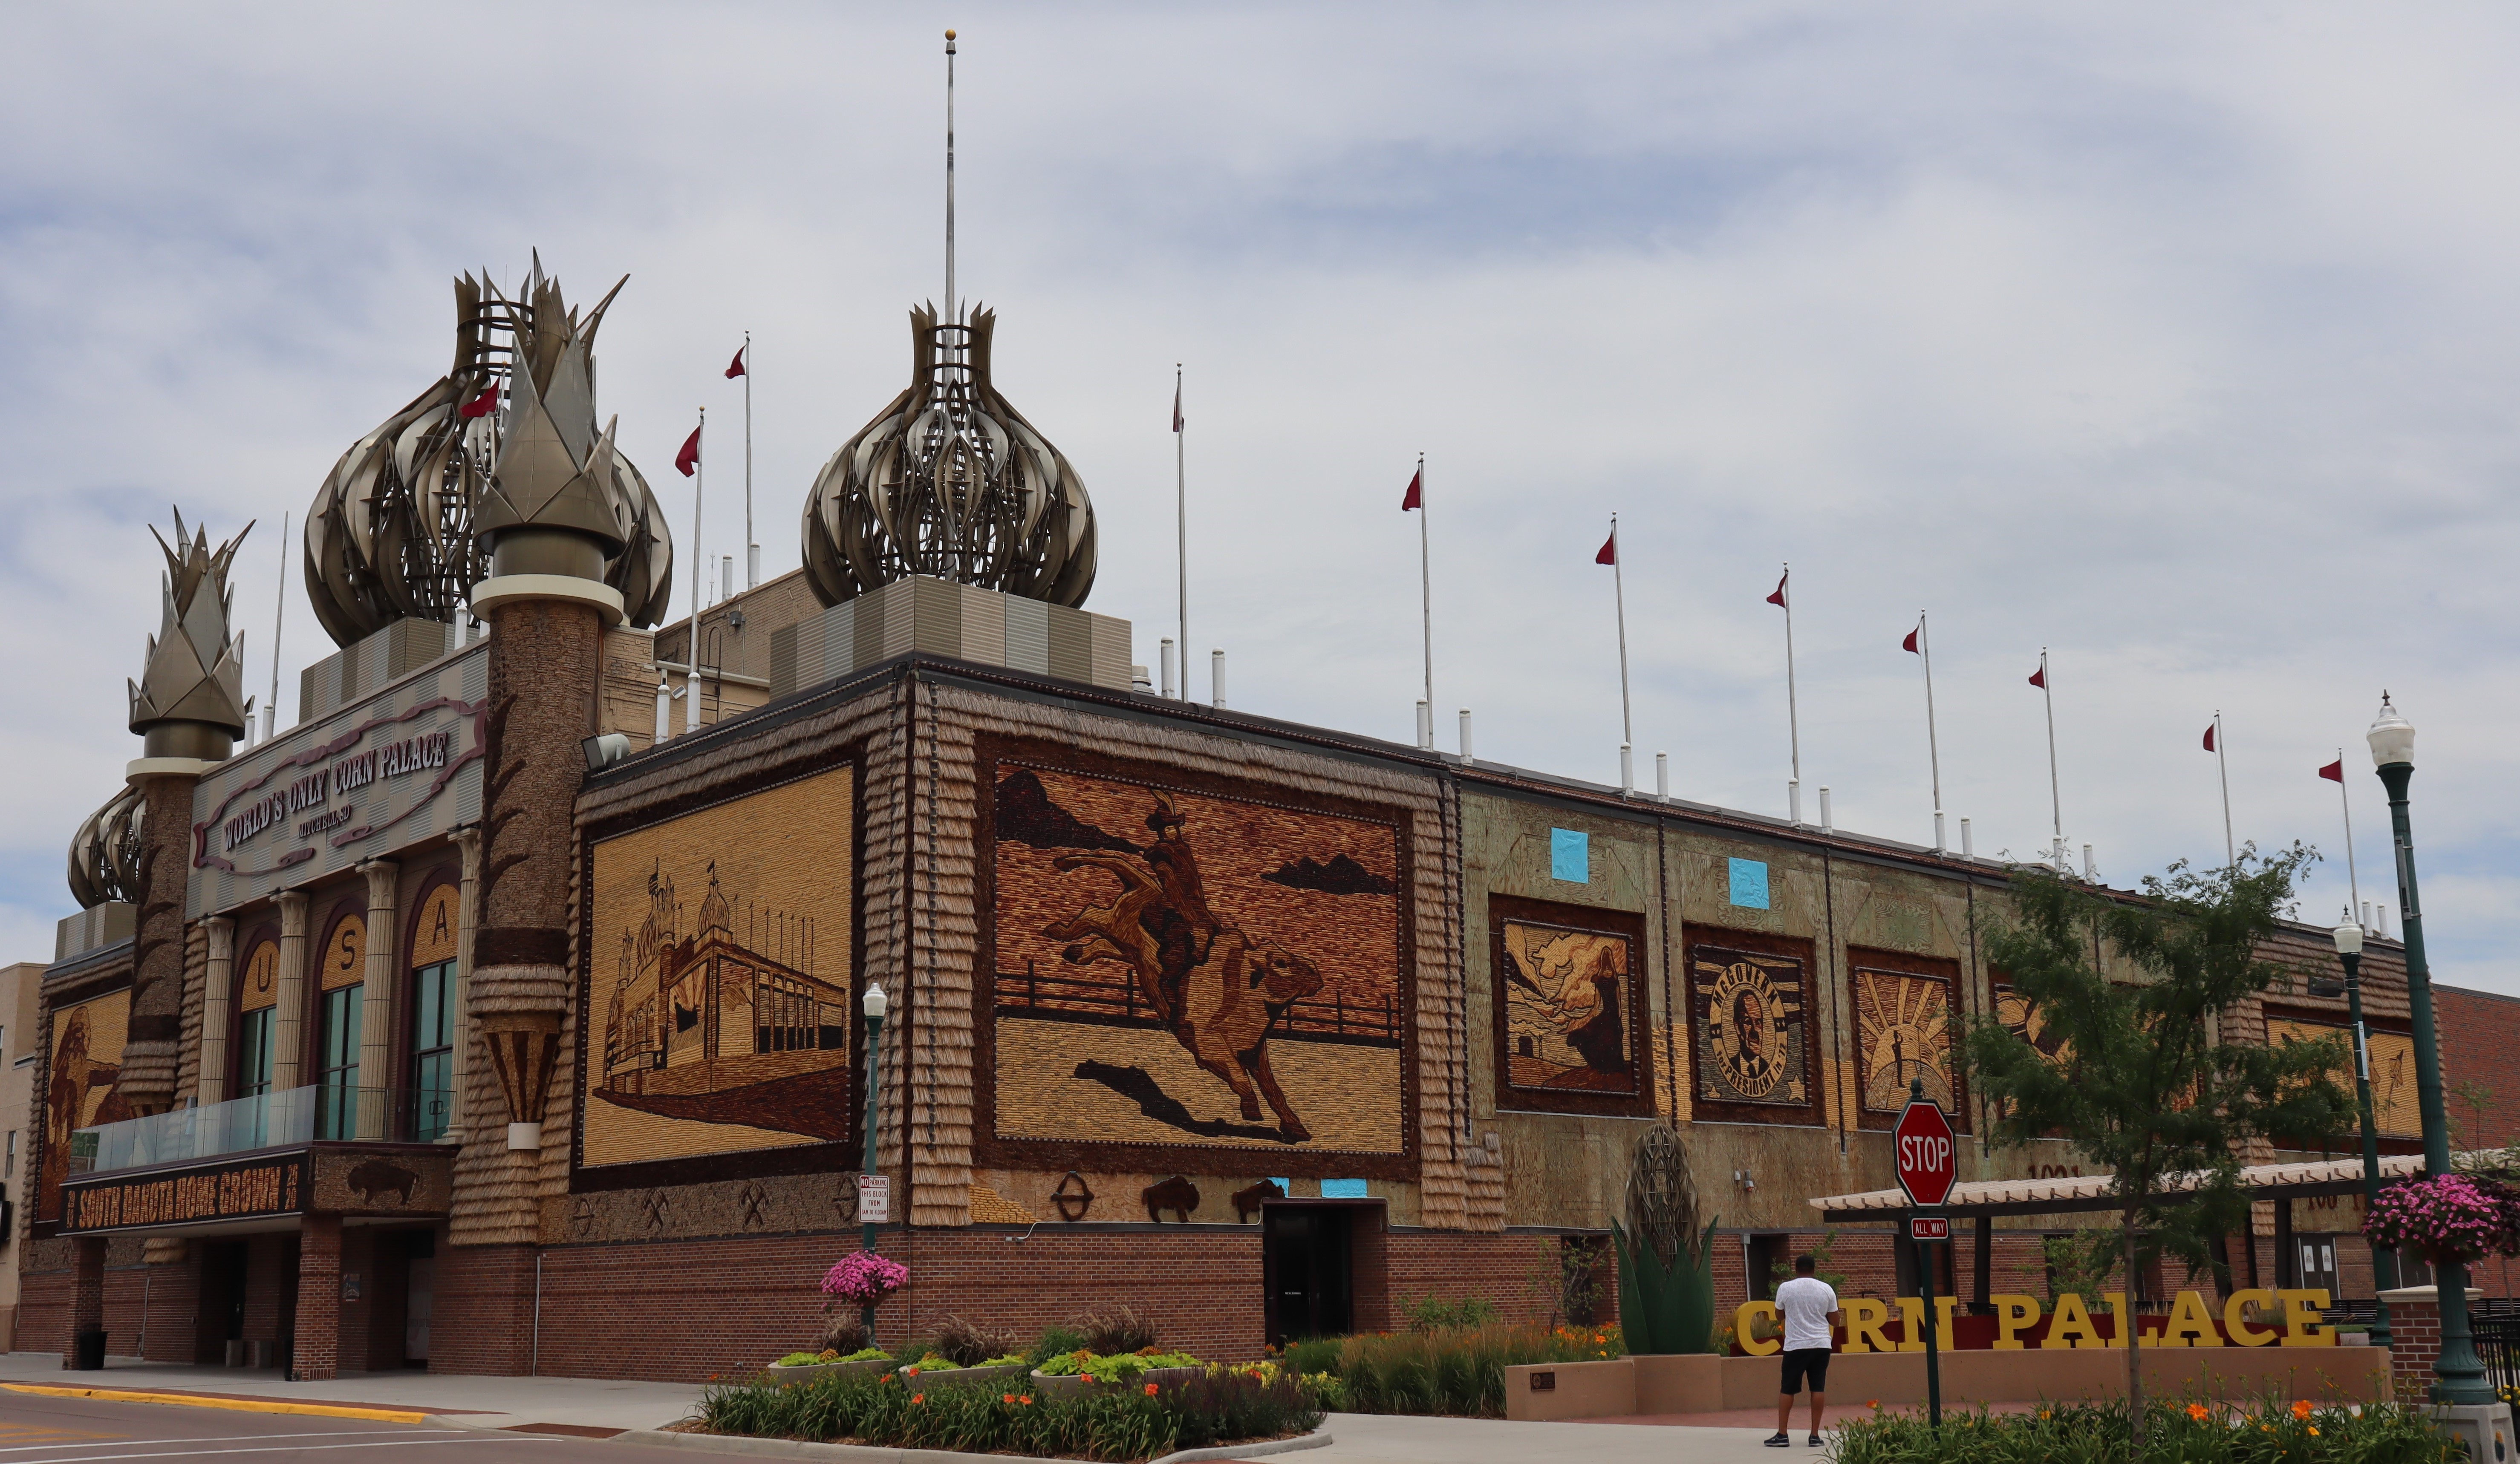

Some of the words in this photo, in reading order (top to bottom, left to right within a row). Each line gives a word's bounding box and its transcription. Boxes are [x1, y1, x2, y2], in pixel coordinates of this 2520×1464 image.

[224, 790, 284, 852] WORLD'S
[289, 768, 328, 813] ONLY
[333, 749, 377, 795] CORN
[379, 732, 448, 778] PALACE
[299, 810, 340, 838] MITCHELL,
[340, 804, 352, 822] SD
[1725, 1066, 1775, 1095] PRESIDENT
[1902, 1135, 1949, 1172] STOP
[79, 1186, 121, 1228] SOUTH
[122, 1180, 173, 1224] DAKOTA
[175, 1175, 217, 1219] HOME
[219, 1166, 280, 1215] GROWN
[861, 1178, 868, 1187] NO
[1915, 1223, 1928, 1234] ALL
[1931, 1223, 1944, 1234] WAY
[1734, 1296, 1957, 1356] CRN
[1989, 1288, 2335, 1350] PALACE
